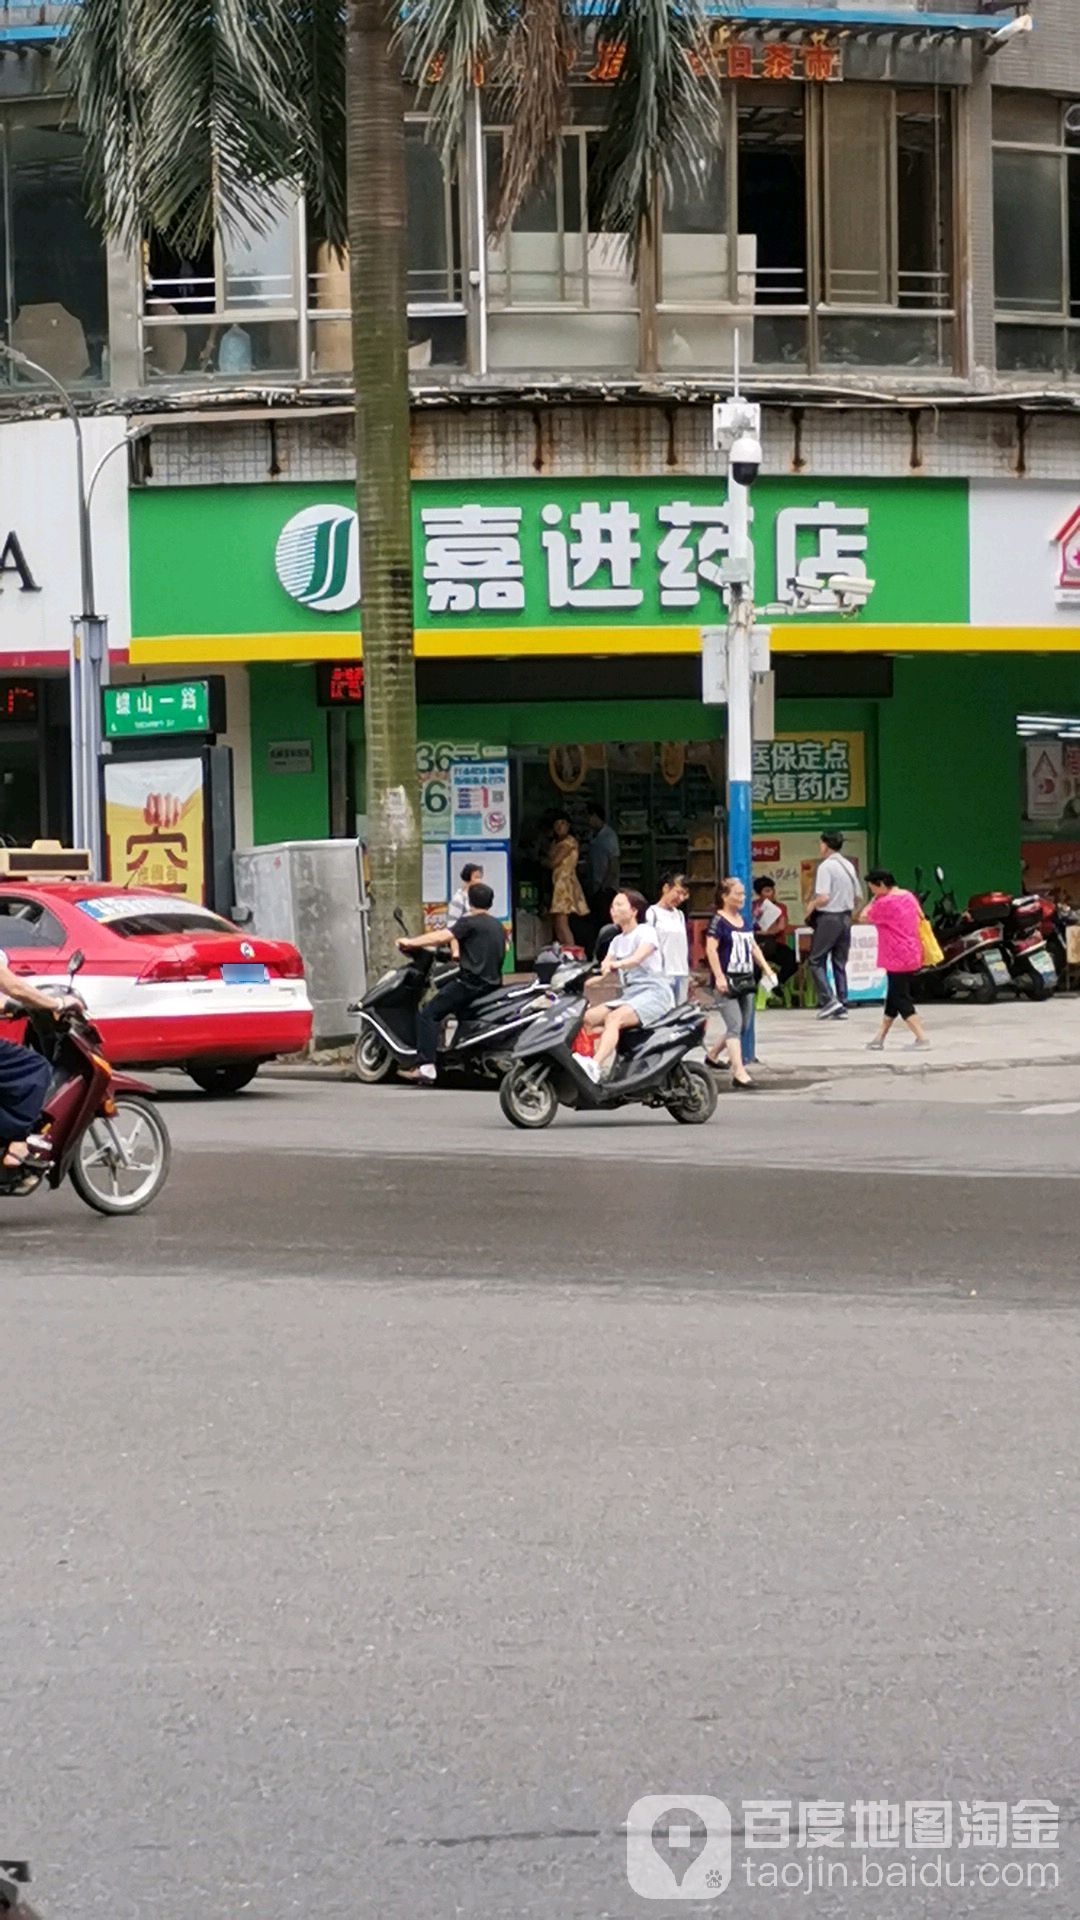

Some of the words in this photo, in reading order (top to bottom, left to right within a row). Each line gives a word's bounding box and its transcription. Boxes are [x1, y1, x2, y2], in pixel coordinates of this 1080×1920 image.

[421, 500, 869, 612] 嘉进药店
[752, 741, 849, 771] 医保定点
[752, 772, 849, 803] 零售药店
